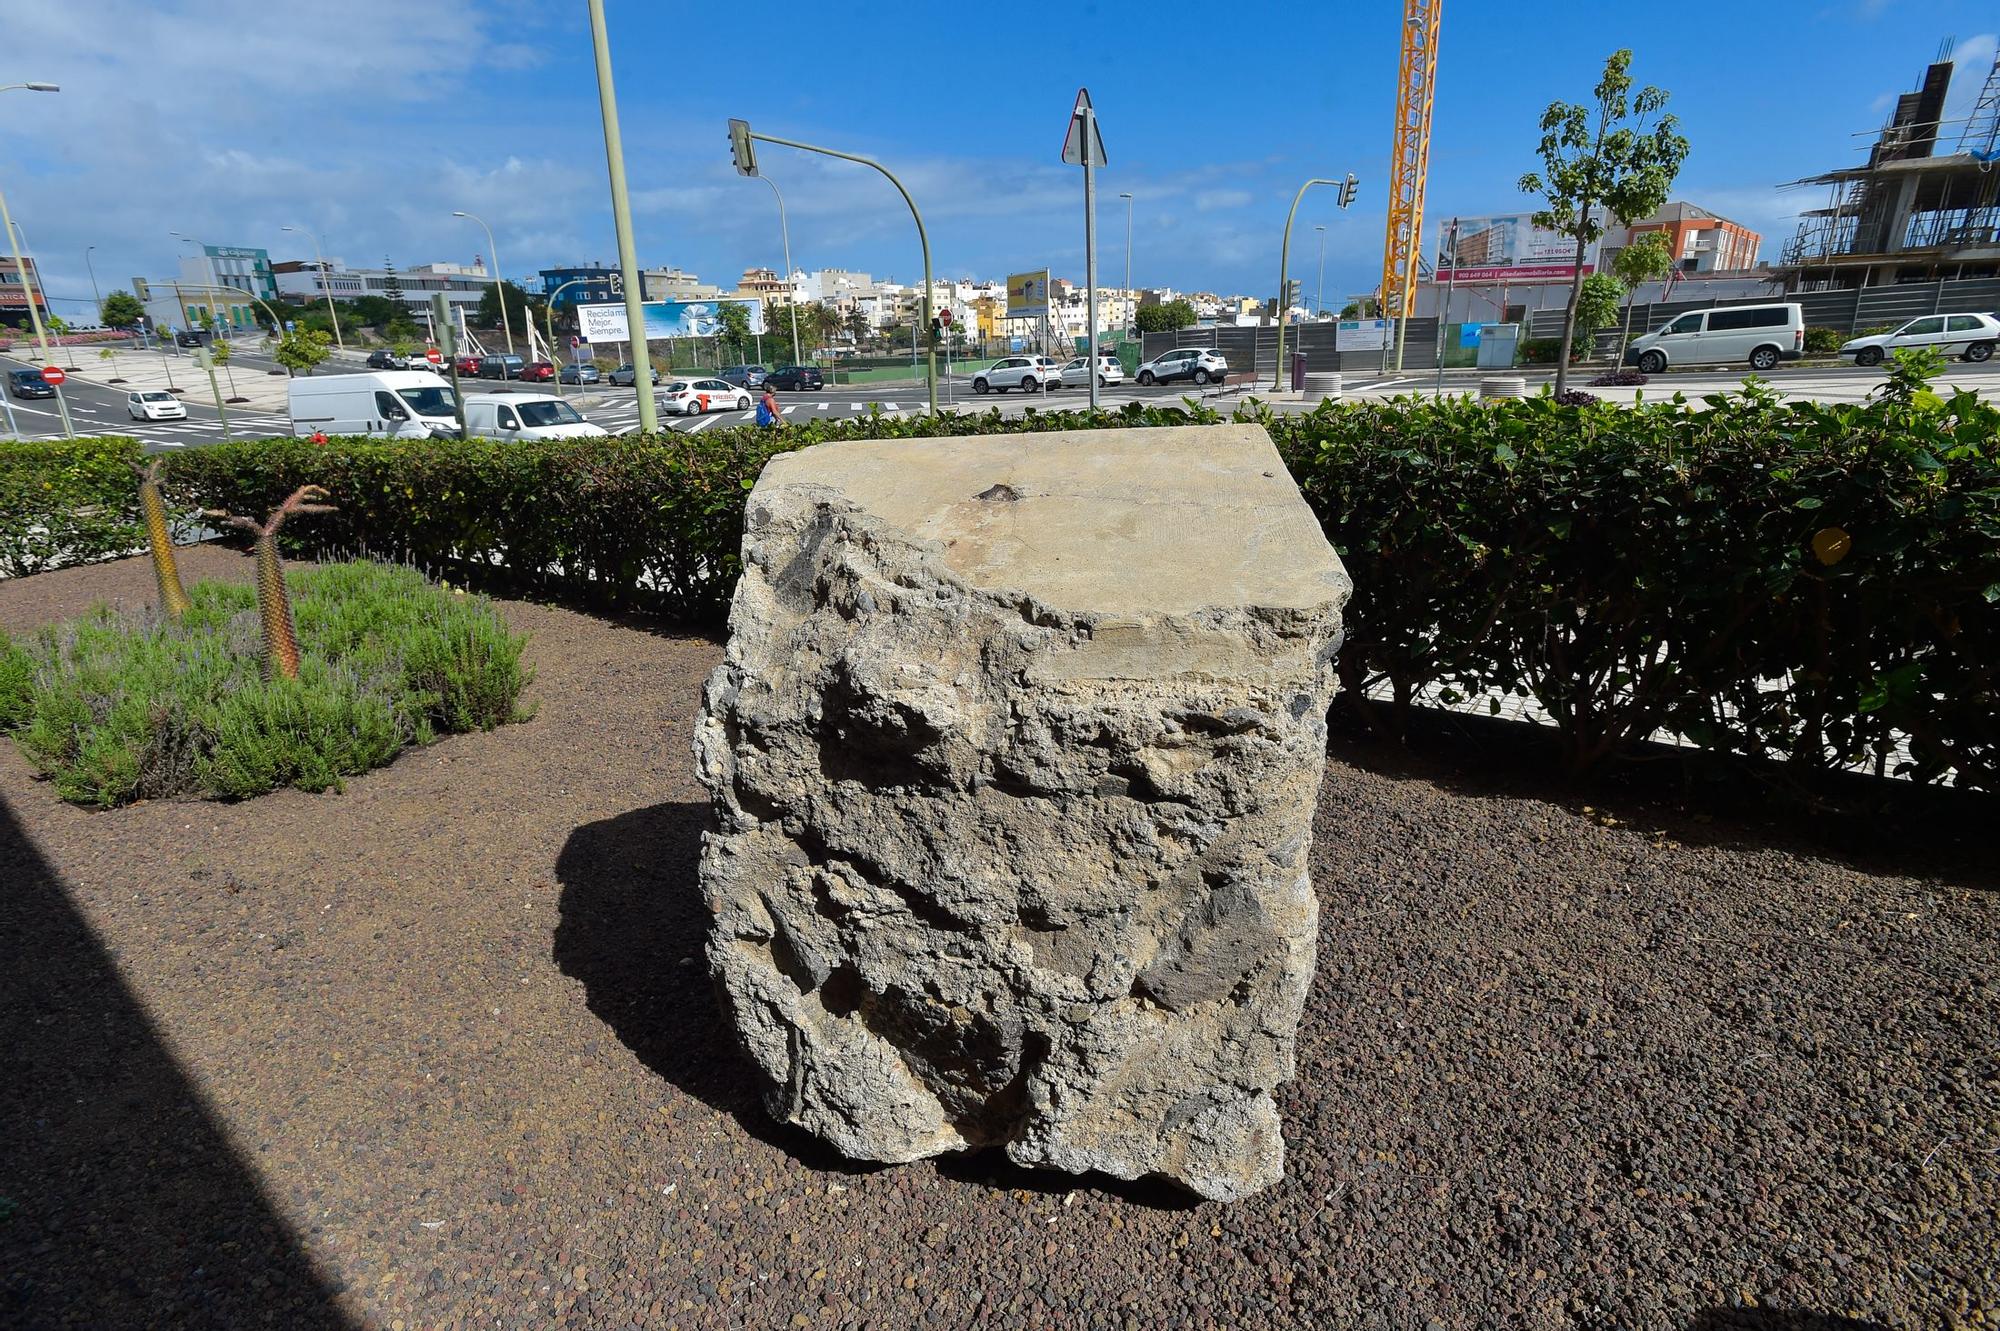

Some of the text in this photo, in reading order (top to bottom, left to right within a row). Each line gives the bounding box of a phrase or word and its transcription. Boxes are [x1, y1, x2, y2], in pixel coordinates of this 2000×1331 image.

[587, 308, 614, 318] Recicla
[588, 318, 613, 328] Mejor.
[589, 326, 624, 336] Siempre.
